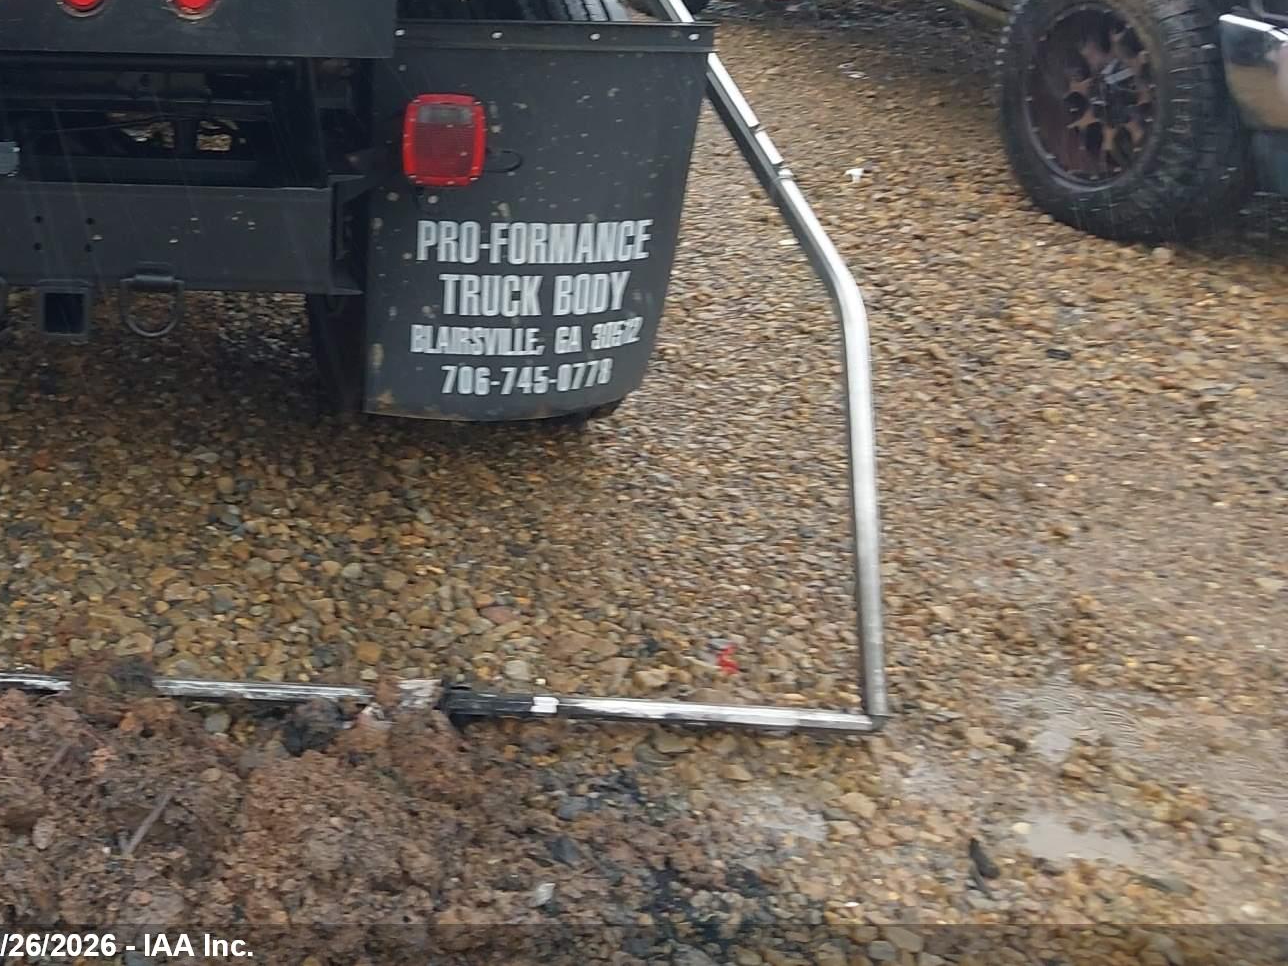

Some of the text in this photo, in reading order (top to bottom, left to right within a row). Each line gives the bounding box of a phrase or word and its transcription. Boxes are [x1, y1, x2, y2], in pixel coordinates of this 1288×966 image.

[416, 219, 654, 265] PRO-FORMANCE
[439, 270, 632, 317] TRUCK BODY
[554, 326, 582, 354] GA
[440, 358, 614, 395] 706-745-0778
